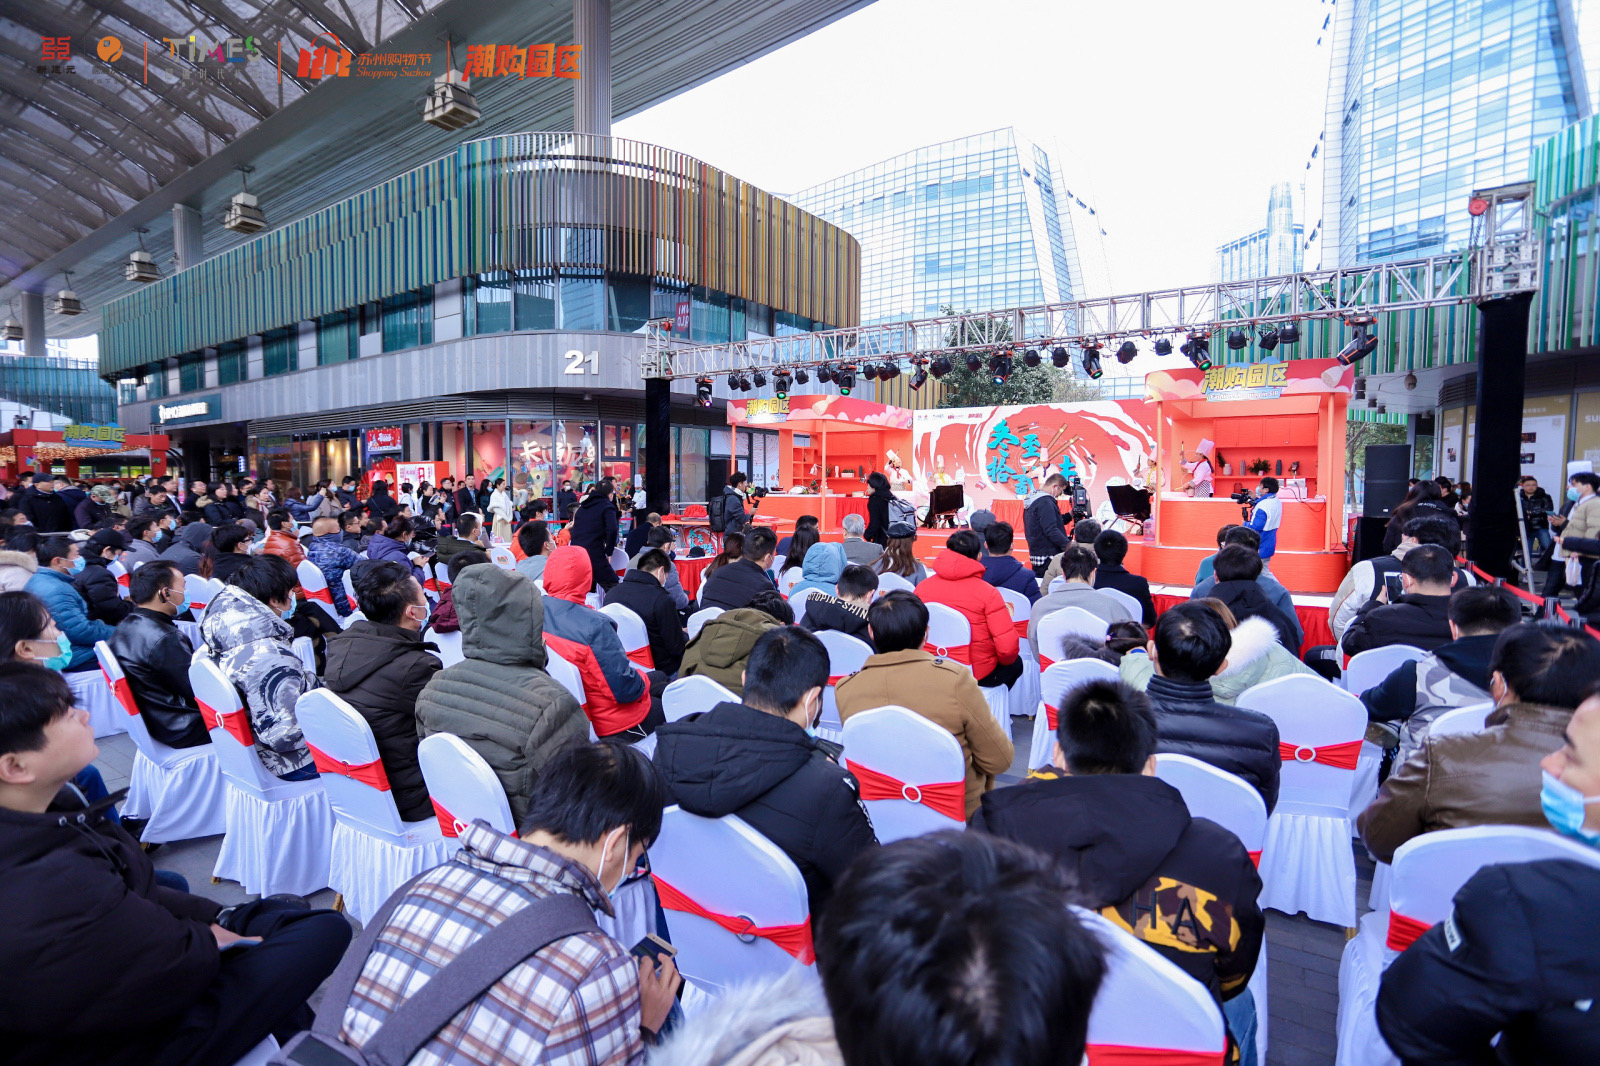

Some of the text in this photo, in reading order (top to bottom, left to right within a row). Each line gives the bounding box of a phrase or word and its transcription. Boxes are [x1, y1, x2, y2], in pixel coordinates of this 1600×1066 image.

[563, 349, 599, 375] 21
[1200, 362, 1289, 394] 潮购园区
[1584, 414, 1600, 423] SU
[987, 419, 1041, 459] 冬至
